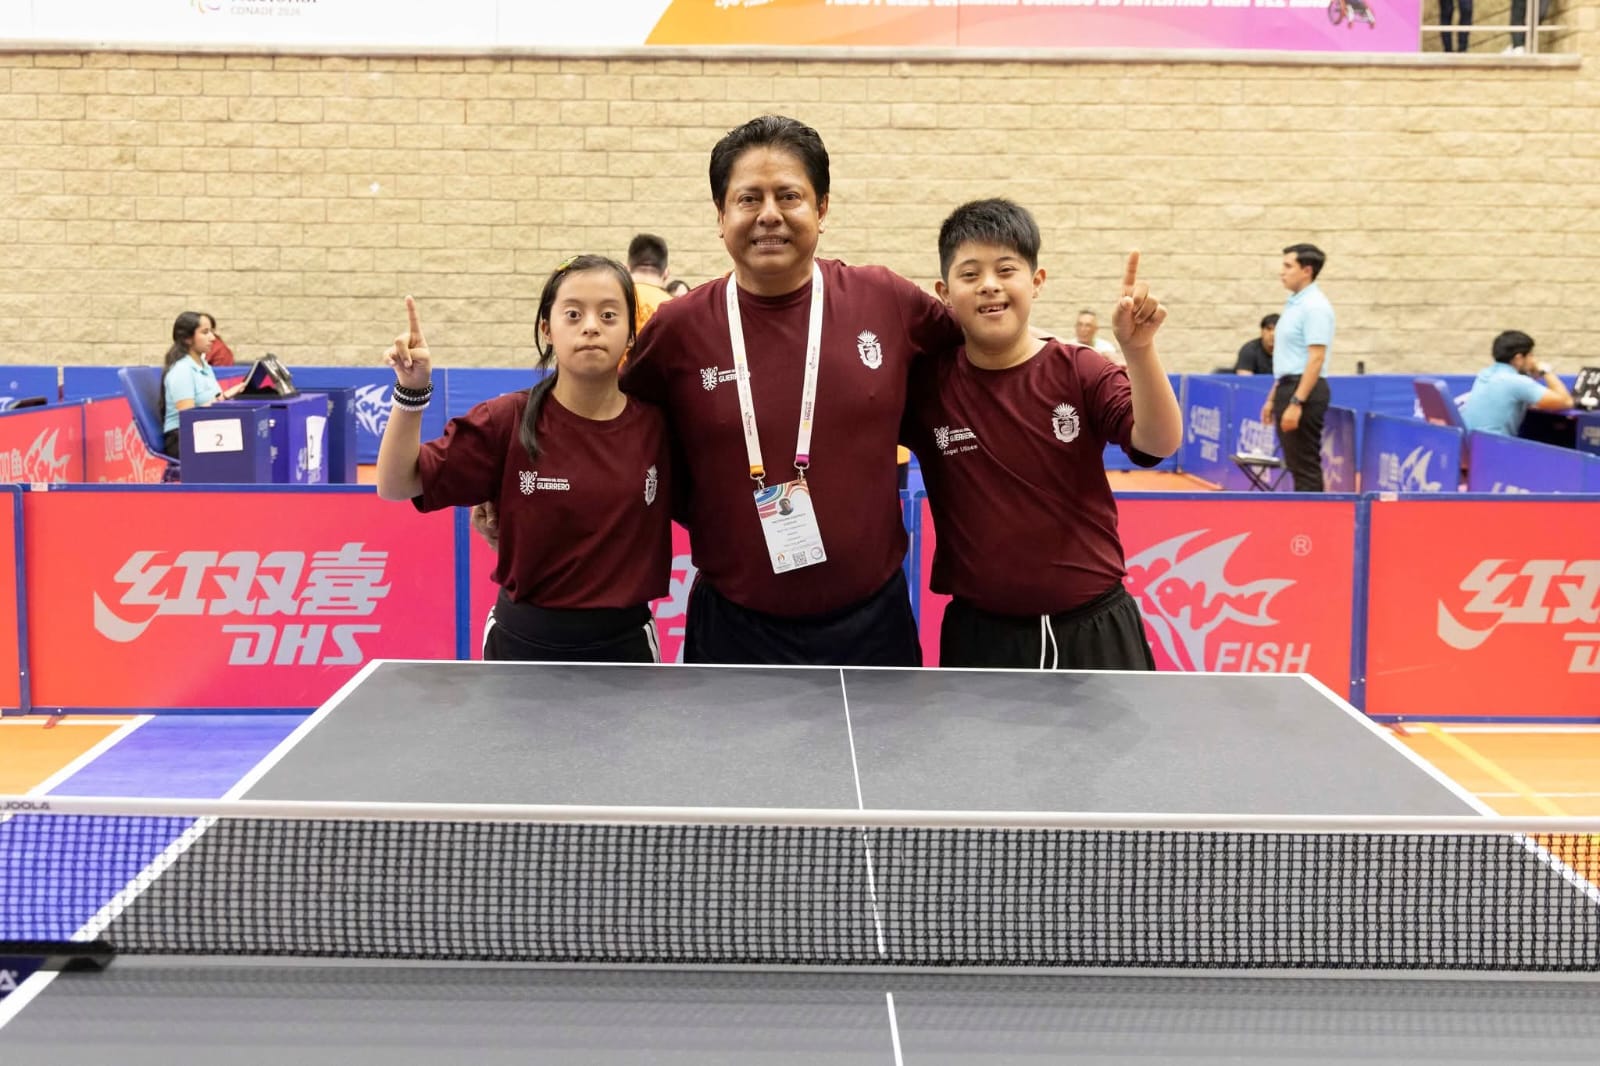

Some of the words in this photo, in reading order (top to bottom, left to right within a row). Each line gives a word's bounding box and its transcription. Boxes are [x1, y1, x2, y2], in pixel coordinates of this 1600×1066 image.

[214, 433, 224, 447] 2
[536, 482, 571, 492] GUERRERO
[93, 542, 392, 643] 红双喜
[221, 624, 381, 665] DHS
[1214, 642, 1311, 673] FISH
[4, 801, 51, 811] JOOLA
